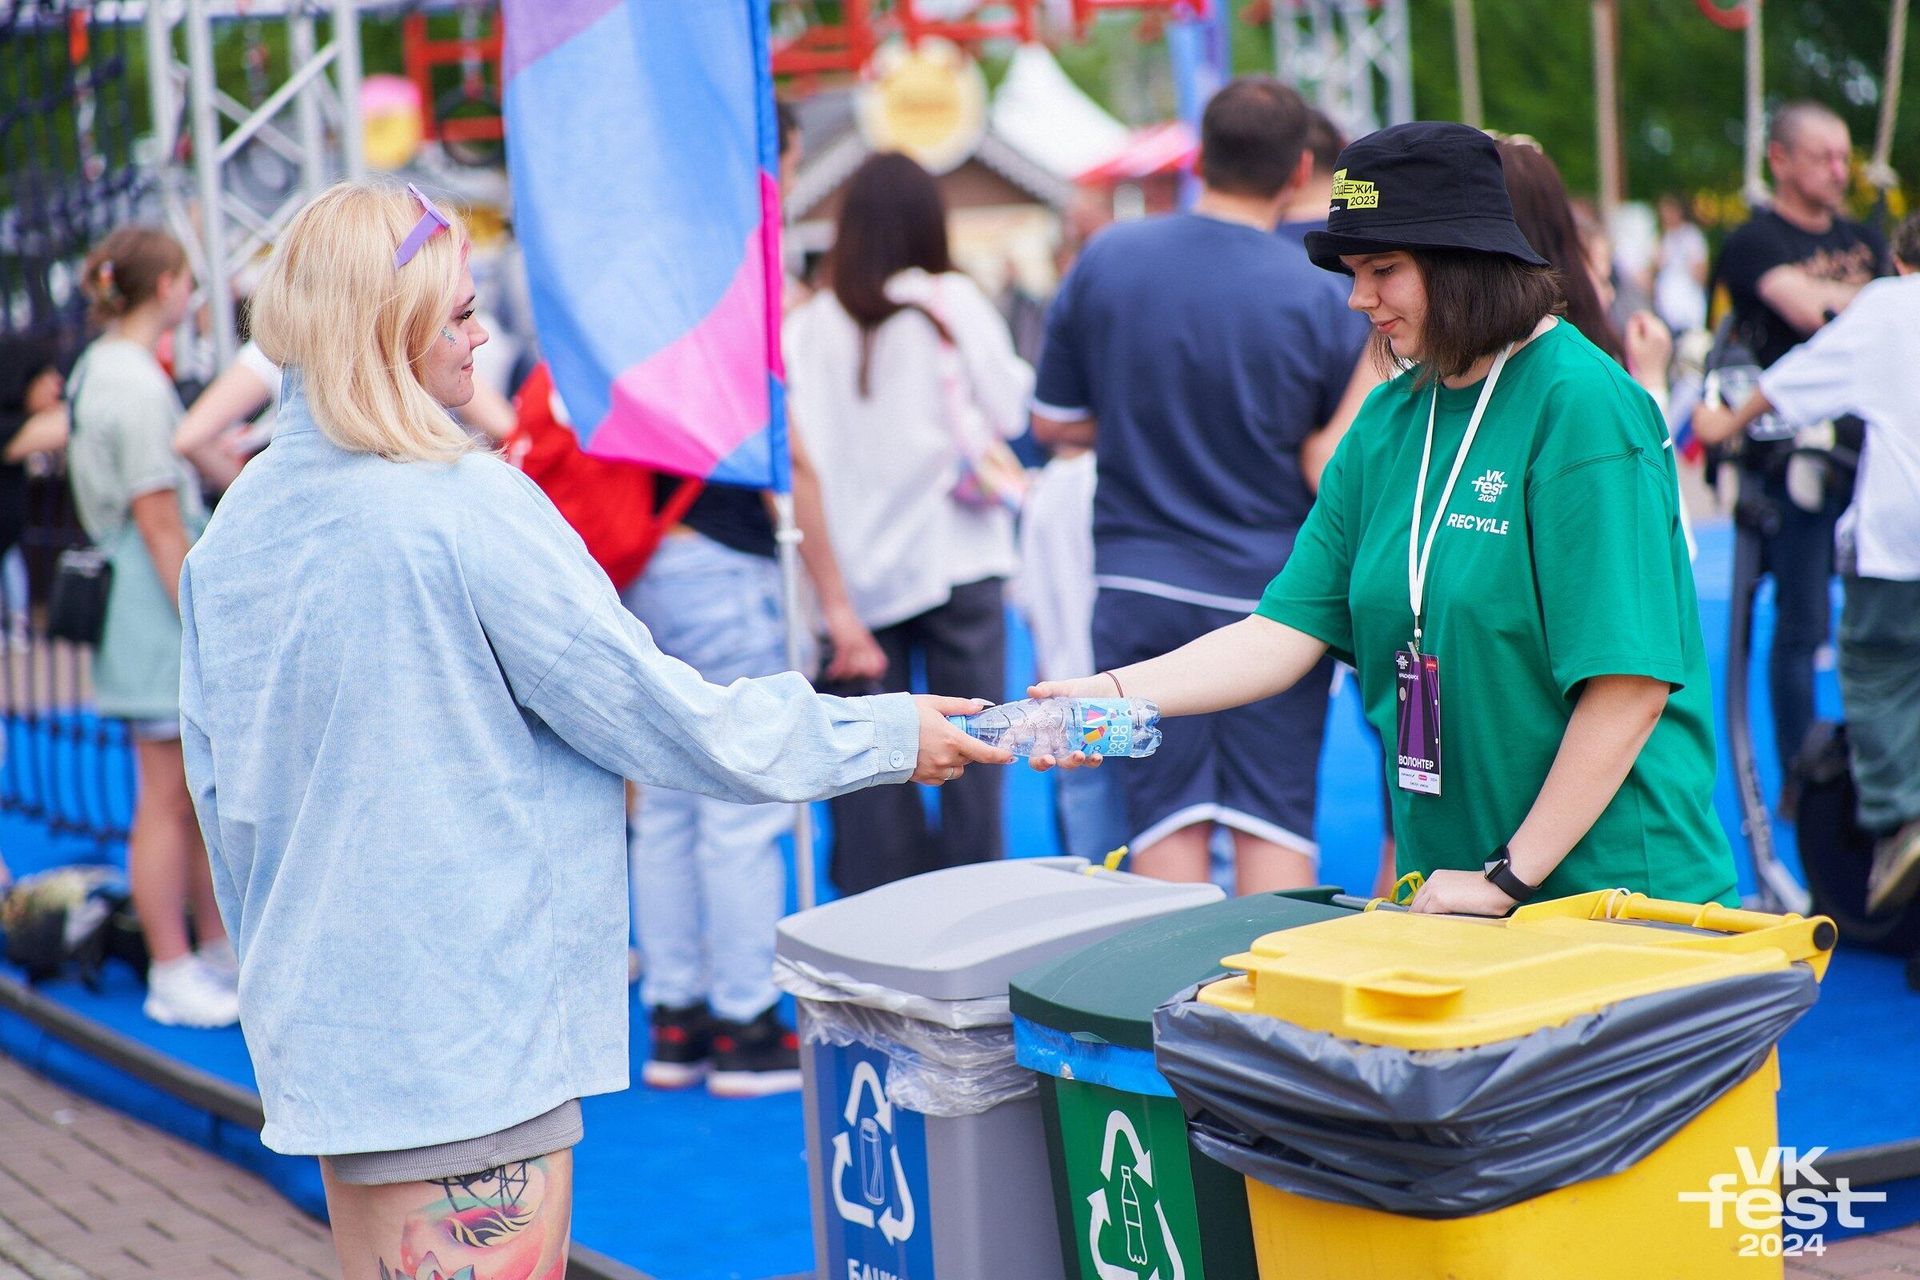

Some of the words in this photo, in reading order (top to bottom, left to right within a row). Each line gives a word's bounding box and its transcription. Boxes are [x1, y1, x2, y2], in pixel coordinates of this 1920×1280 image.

[1350, 196, 1376, 206] 2023
[1487, 470, 1505, 483] VK
[1471, 477, 1508, 495] fest
[1477, 494, 1496, 503] 2024
[1447, 513, 1509, 535] RECYCLE
[1398, 755, 1434, 770] ВОЛОНТЕР
